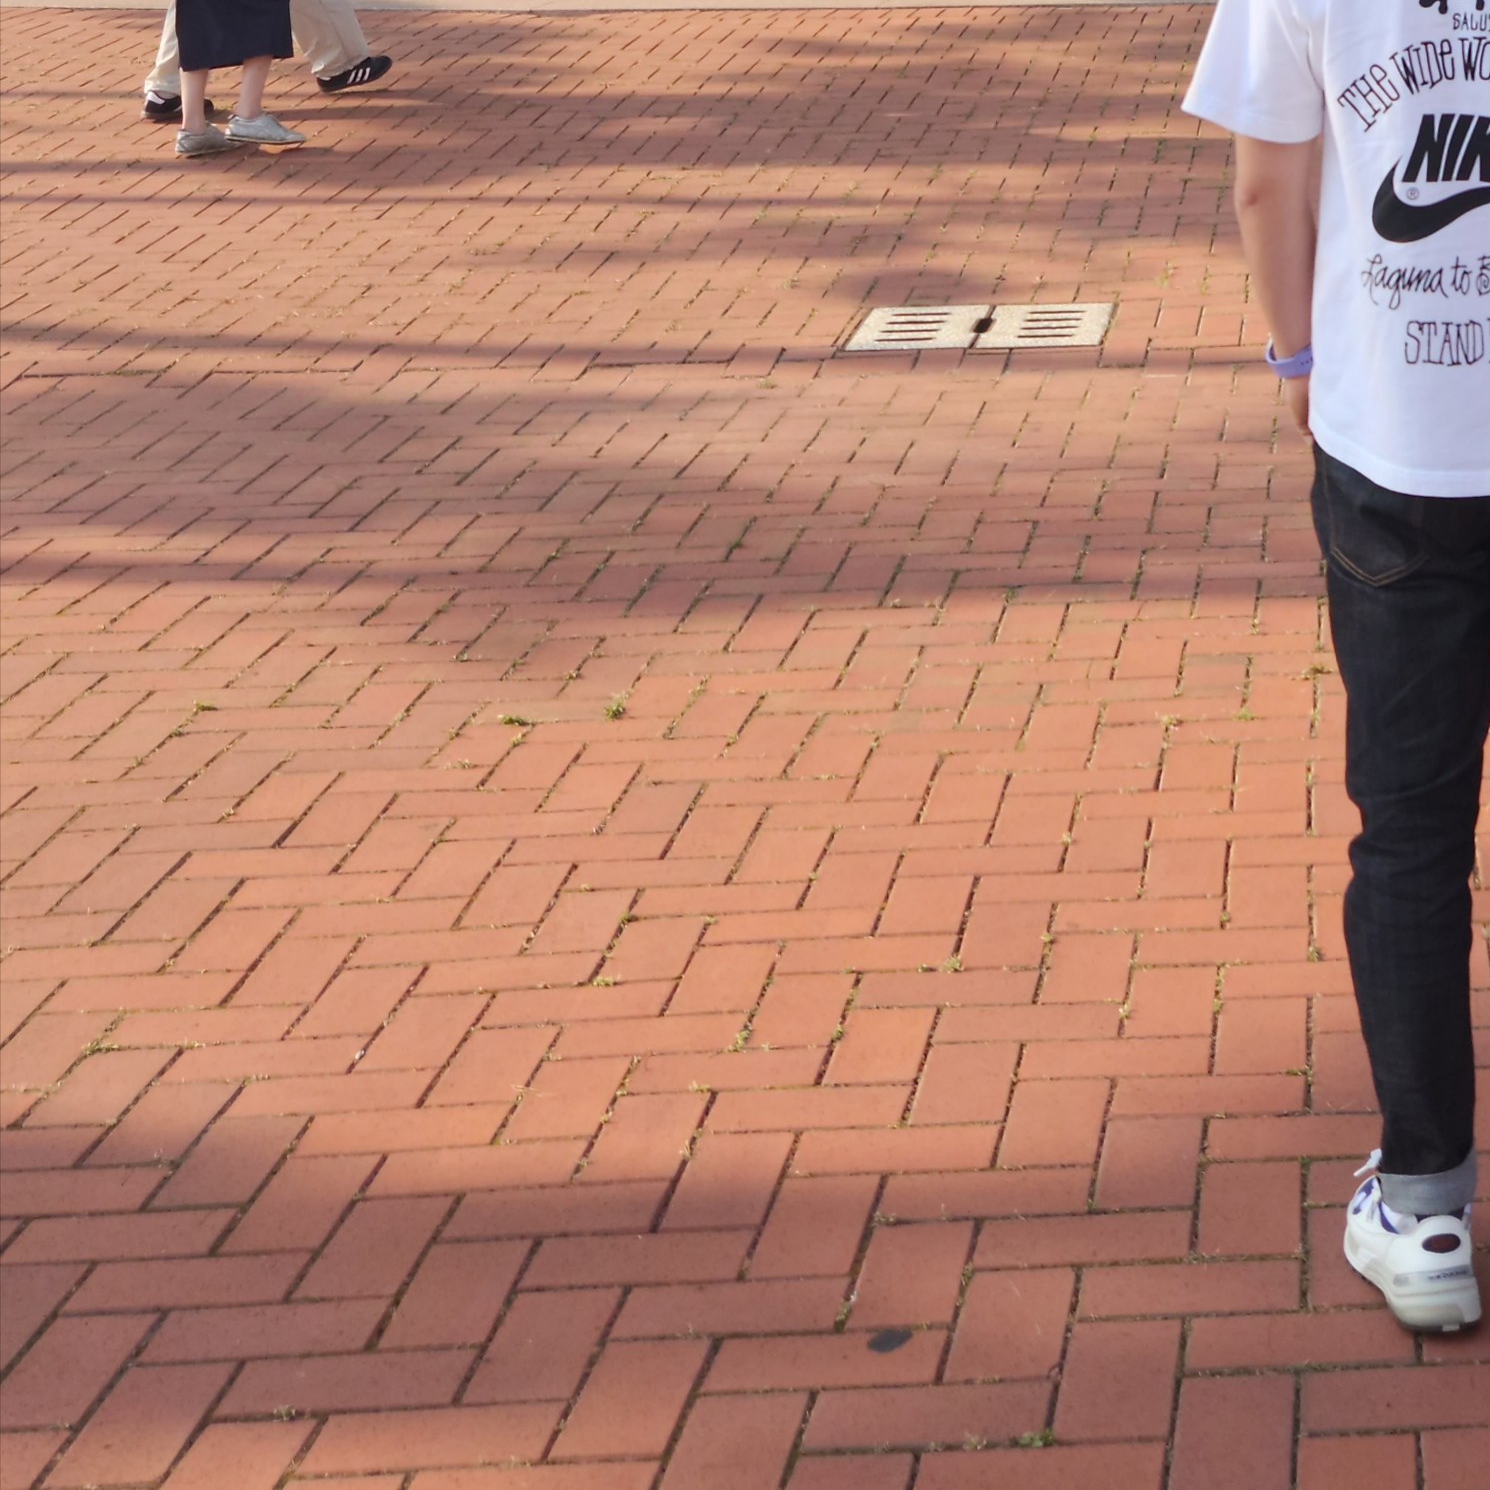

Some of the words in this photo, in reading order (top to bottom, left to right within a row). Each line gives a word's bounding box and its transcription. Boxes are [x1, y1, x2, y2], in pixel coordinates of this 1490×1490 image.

[1361, 253, 1448, 310] Laguna
[1449, 256, 1473, 296] to
[1404, 318, 1484, 367] STAND
